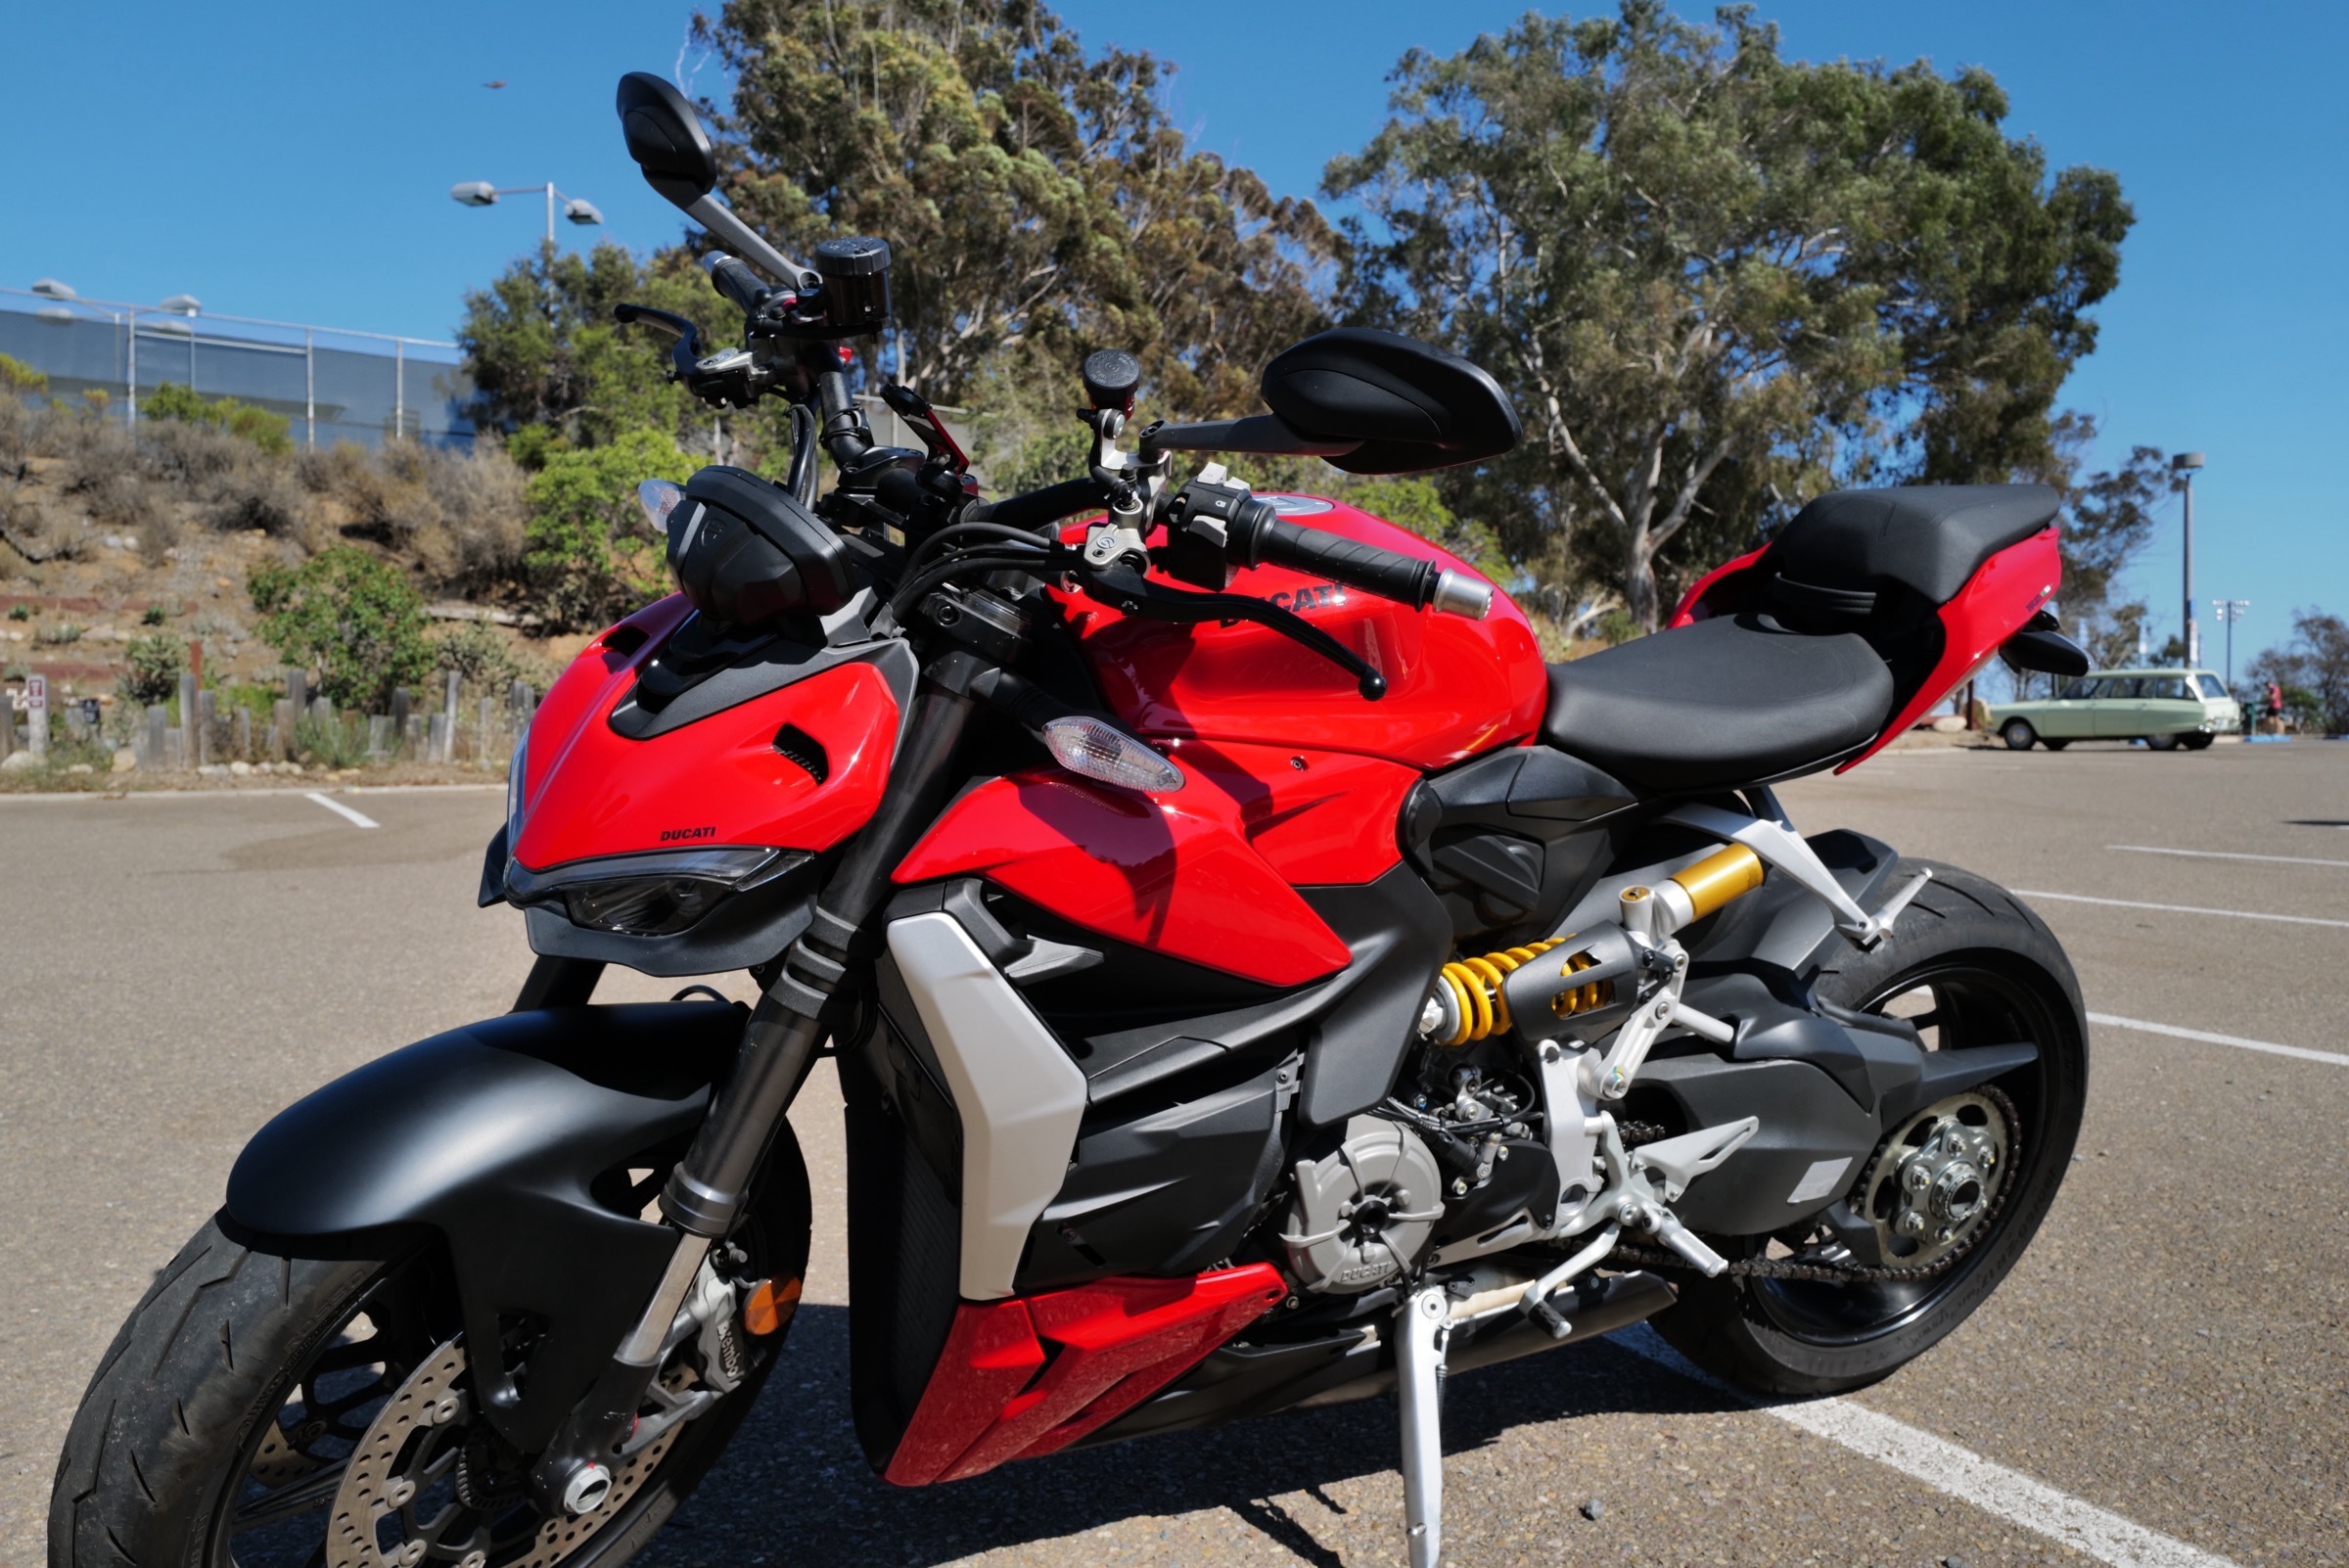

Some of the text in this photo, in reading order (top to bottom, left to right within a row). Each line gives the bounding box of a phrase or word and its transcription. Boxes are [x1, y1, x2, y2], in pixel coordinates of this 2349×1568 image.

[660, 826, 716, 842] DUCATI
[1340, 1261, 1392, 1283] DUCATI
[286, 1270, 366, 1352] ROSSO
